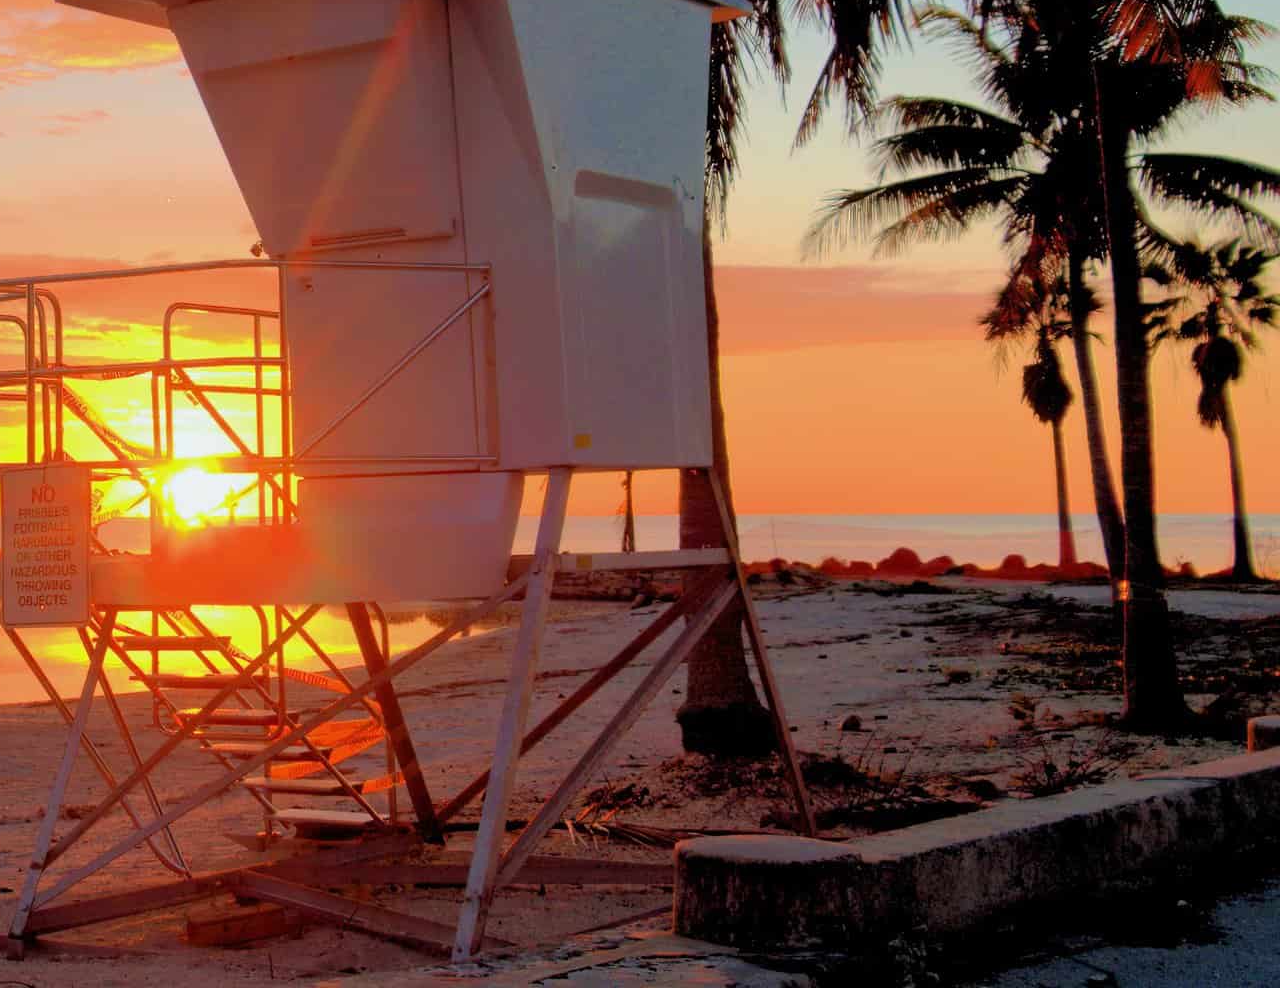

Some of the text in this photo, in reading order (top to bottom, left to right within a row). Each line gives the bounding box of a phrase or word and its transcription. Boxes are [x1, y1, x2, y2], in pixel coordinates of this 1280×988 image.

[32, 486, 55, 503] NO
[35, 550, 71, 562] OTHER
[11, 564, 78, 578] HAZARDOUS
[16, 580, 72, 592] THROWING
[18, 595, 68, 607] OBJECTS
